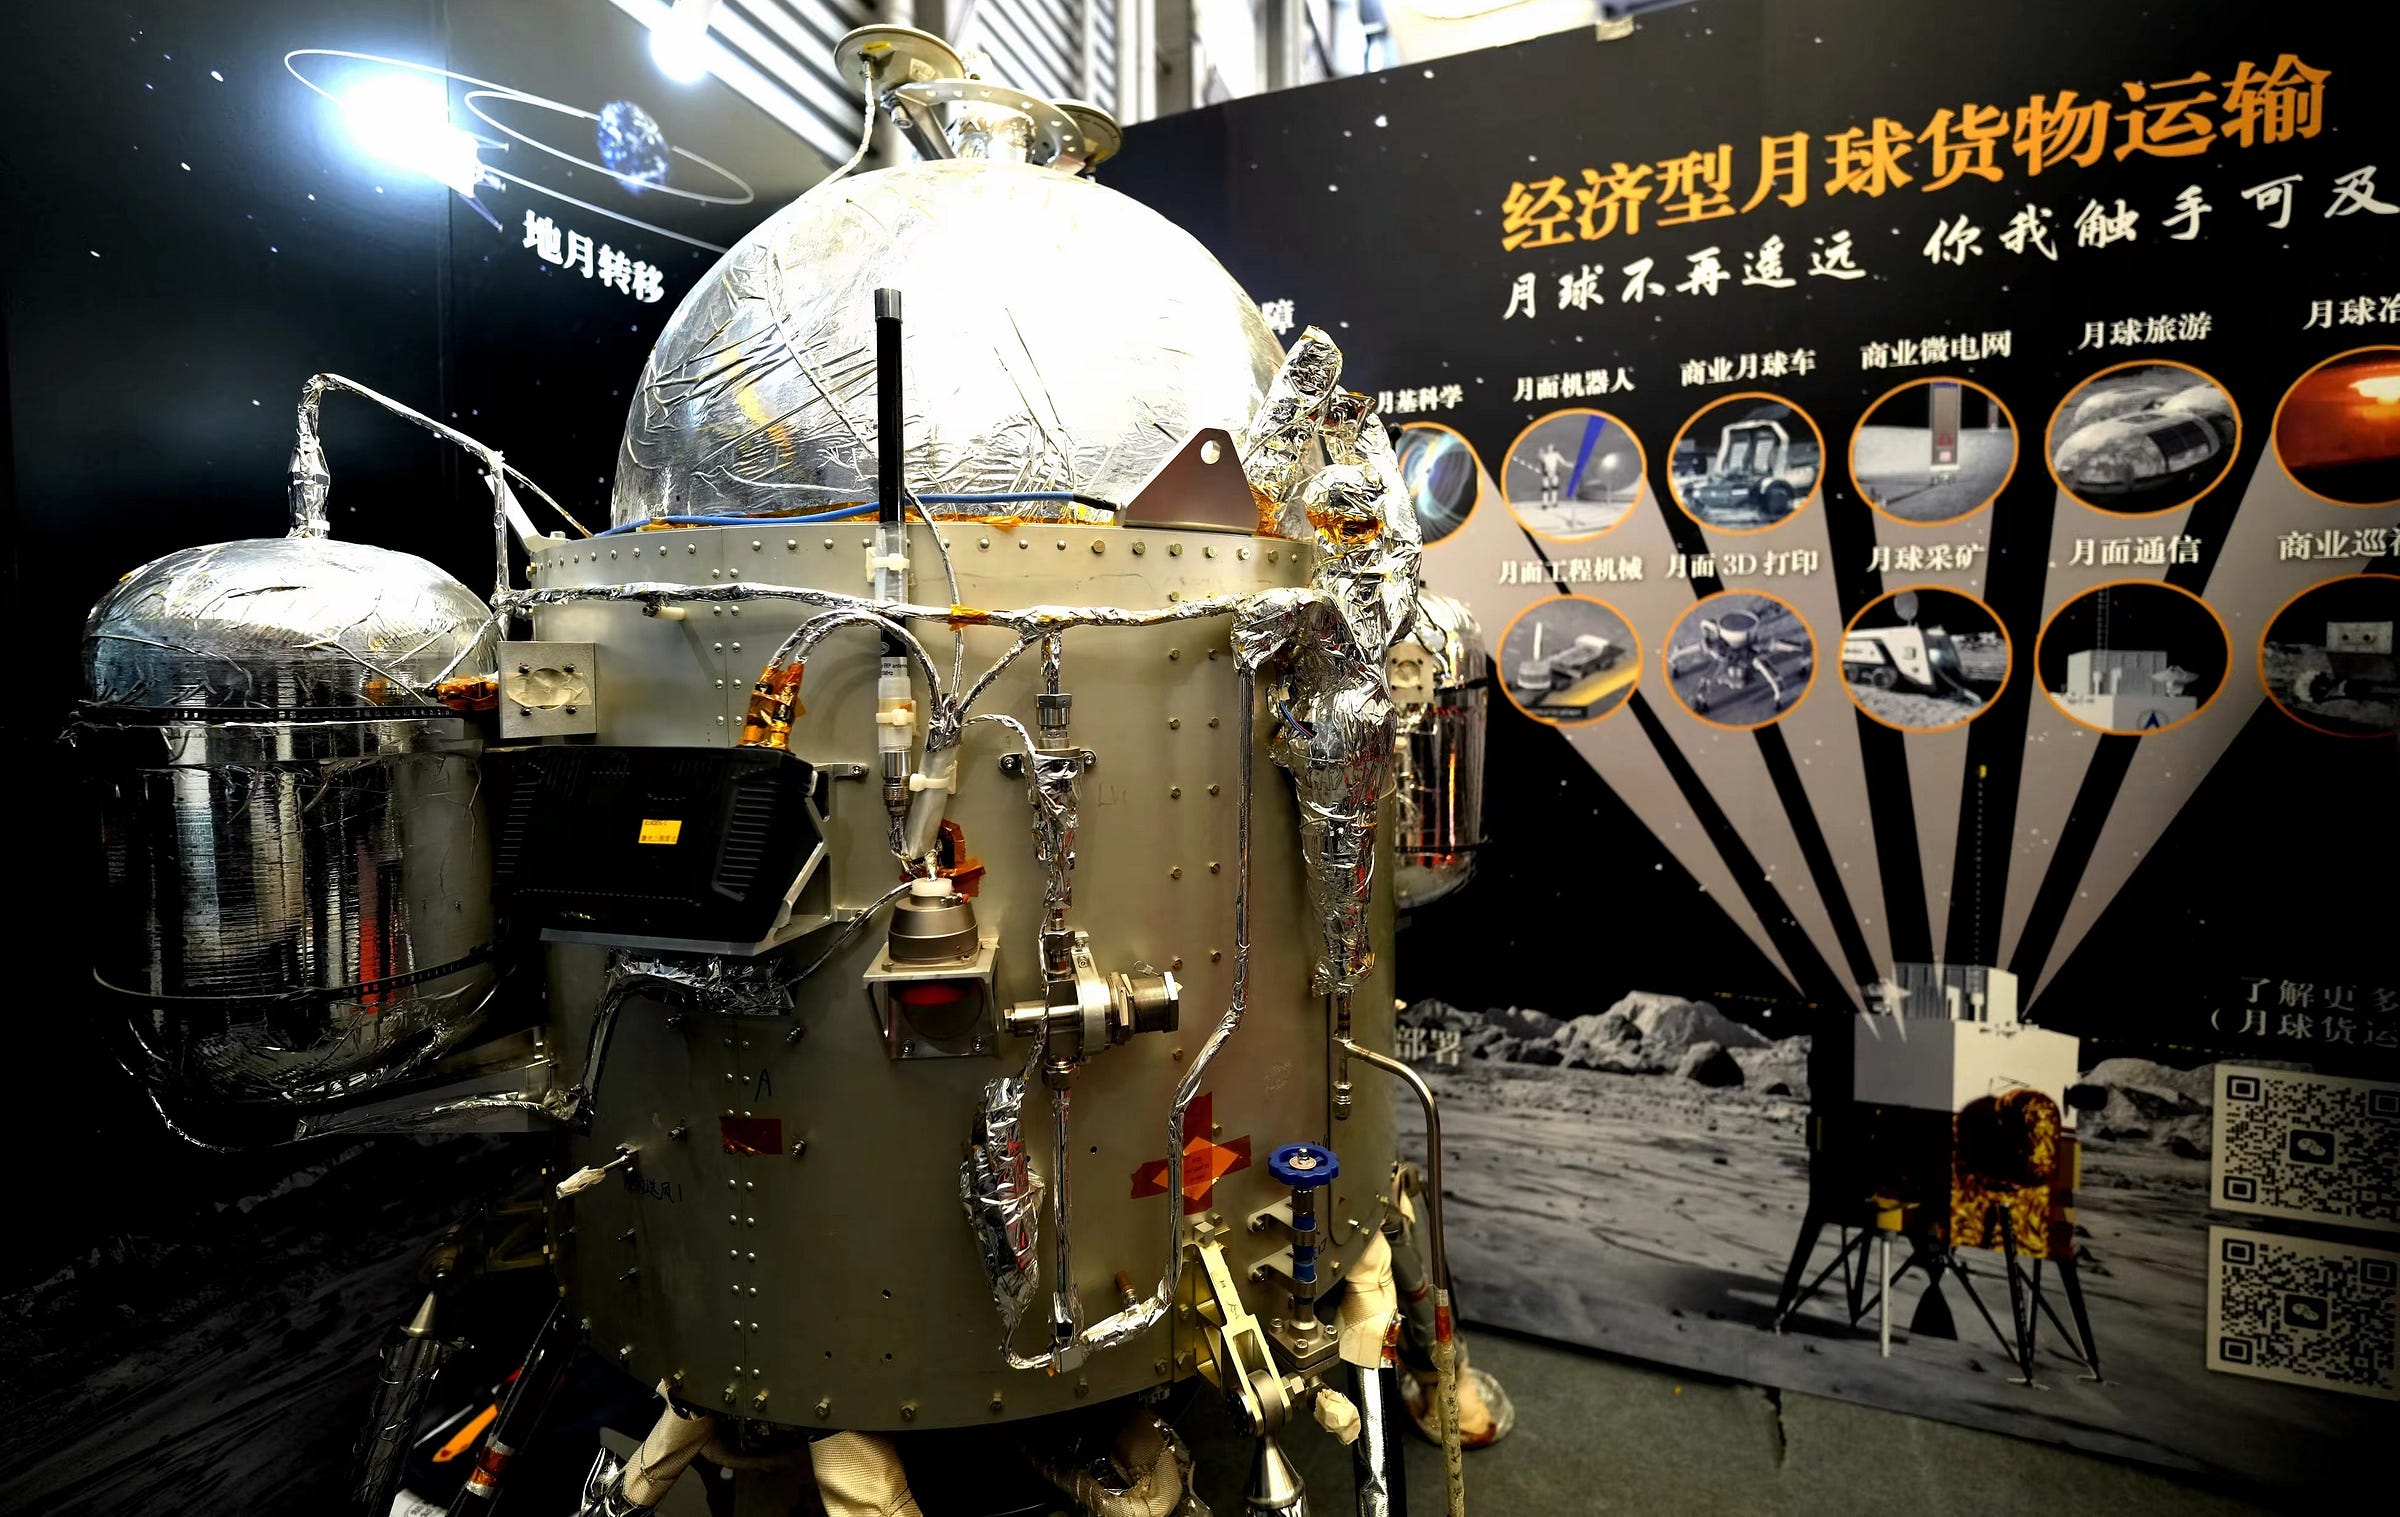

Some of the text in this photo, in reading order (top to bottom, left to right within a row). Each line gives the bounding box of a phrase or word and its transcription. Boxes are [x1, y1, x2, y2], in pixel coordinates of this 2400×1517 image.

[1501, 53, 2333, 253] 经济型月球货物运输
[522, 209, 666, 304] 地月转移
[1502, 165, 2400, 322] 月球不再遥远 你我触手可及
[2078, 311, 2212, 350] 月球旅游
[1680, 348, 1817, 387] 商业月球车
[1860, 330, 2012, 371] 商业微电网
[1513, 367, 1635, 402] 月面机器人
[1498, 554, 1643, 584] 月面工程机械
[1867, 542, 1985, 573] 月球采矿
[2068, 534, 2202, 567] 月面通信
[2240, 976, 2400, 1014] 了解更多
[755, 1067, 772, 1102] A
